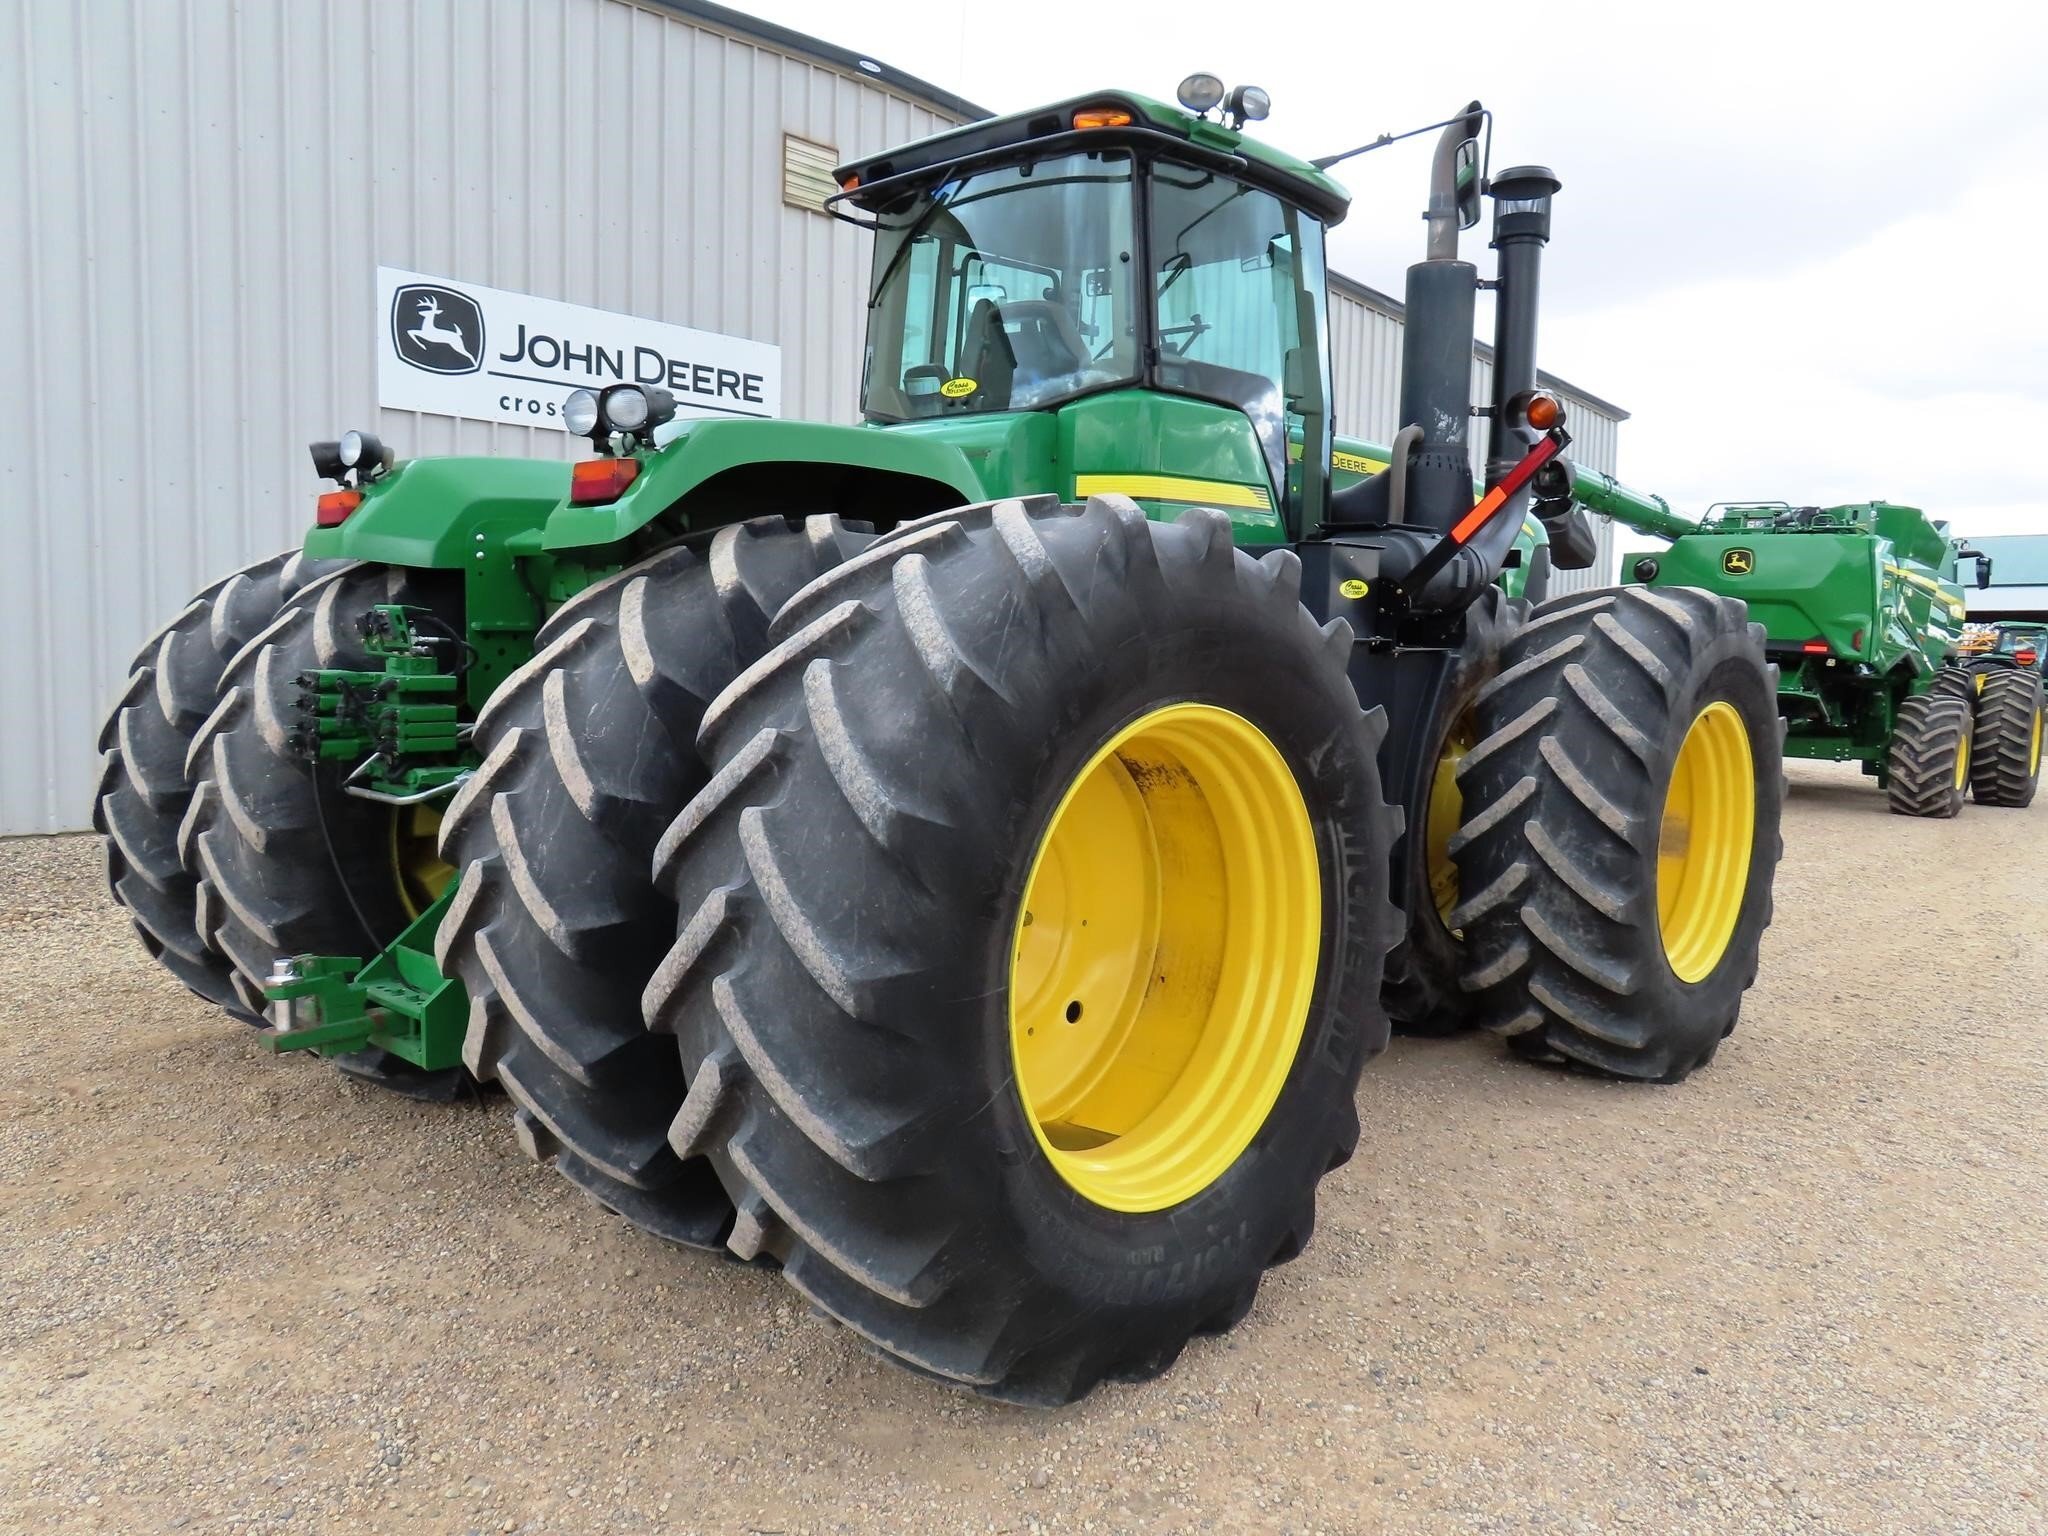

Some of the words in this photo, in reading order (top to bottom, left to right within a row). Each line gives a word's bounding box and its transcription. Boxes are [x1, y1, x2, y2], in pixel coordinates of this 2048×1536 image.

[499, 323, 623, 380] JOHN
[634, 345, 764, 404] DEERE
[1332, 454, 1368, 472] DEERE
